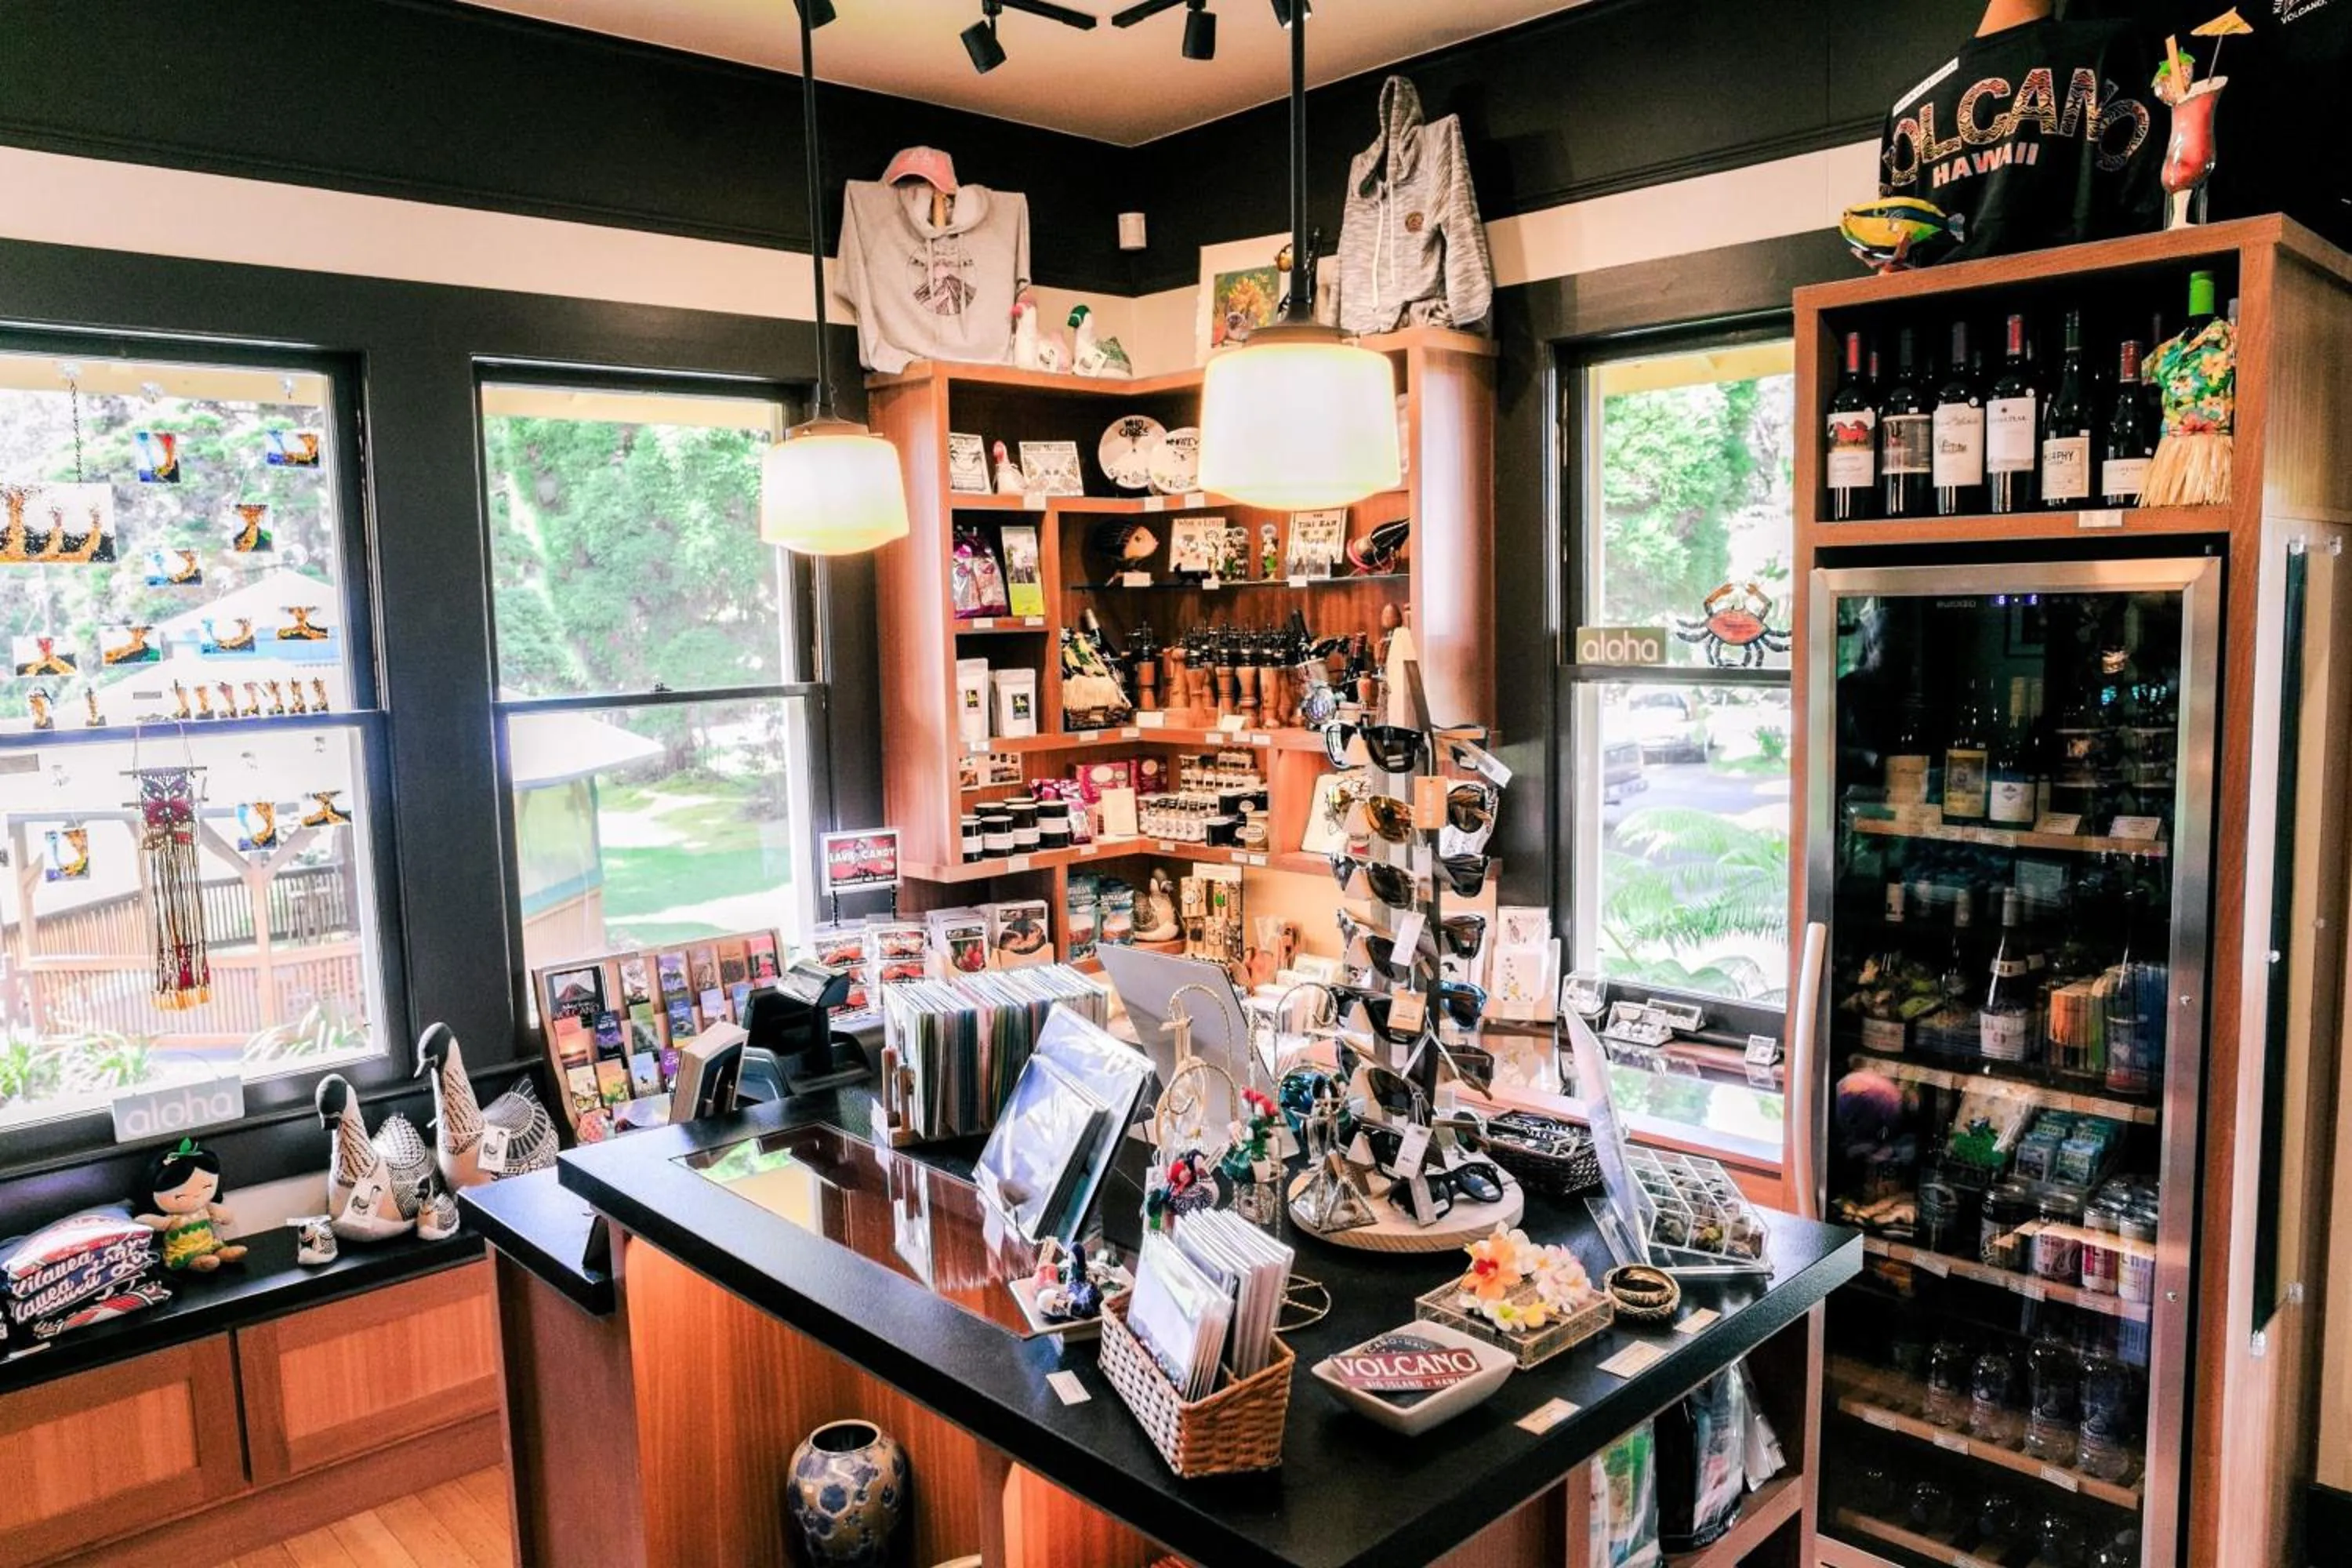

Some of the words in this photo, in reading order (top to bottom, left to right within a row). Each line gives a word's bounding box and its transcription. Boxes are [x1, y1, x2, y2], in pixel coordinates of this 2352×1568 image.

[1882, 67, 2150, 188] OLCANO
[1932, 142, 2038, 188] HAWAII
[1582, 630, 1658, 662] aloha
[125, 1087, 233, 1136] aloha
[1334, 1352, 1478, 1377] VOLCANO
